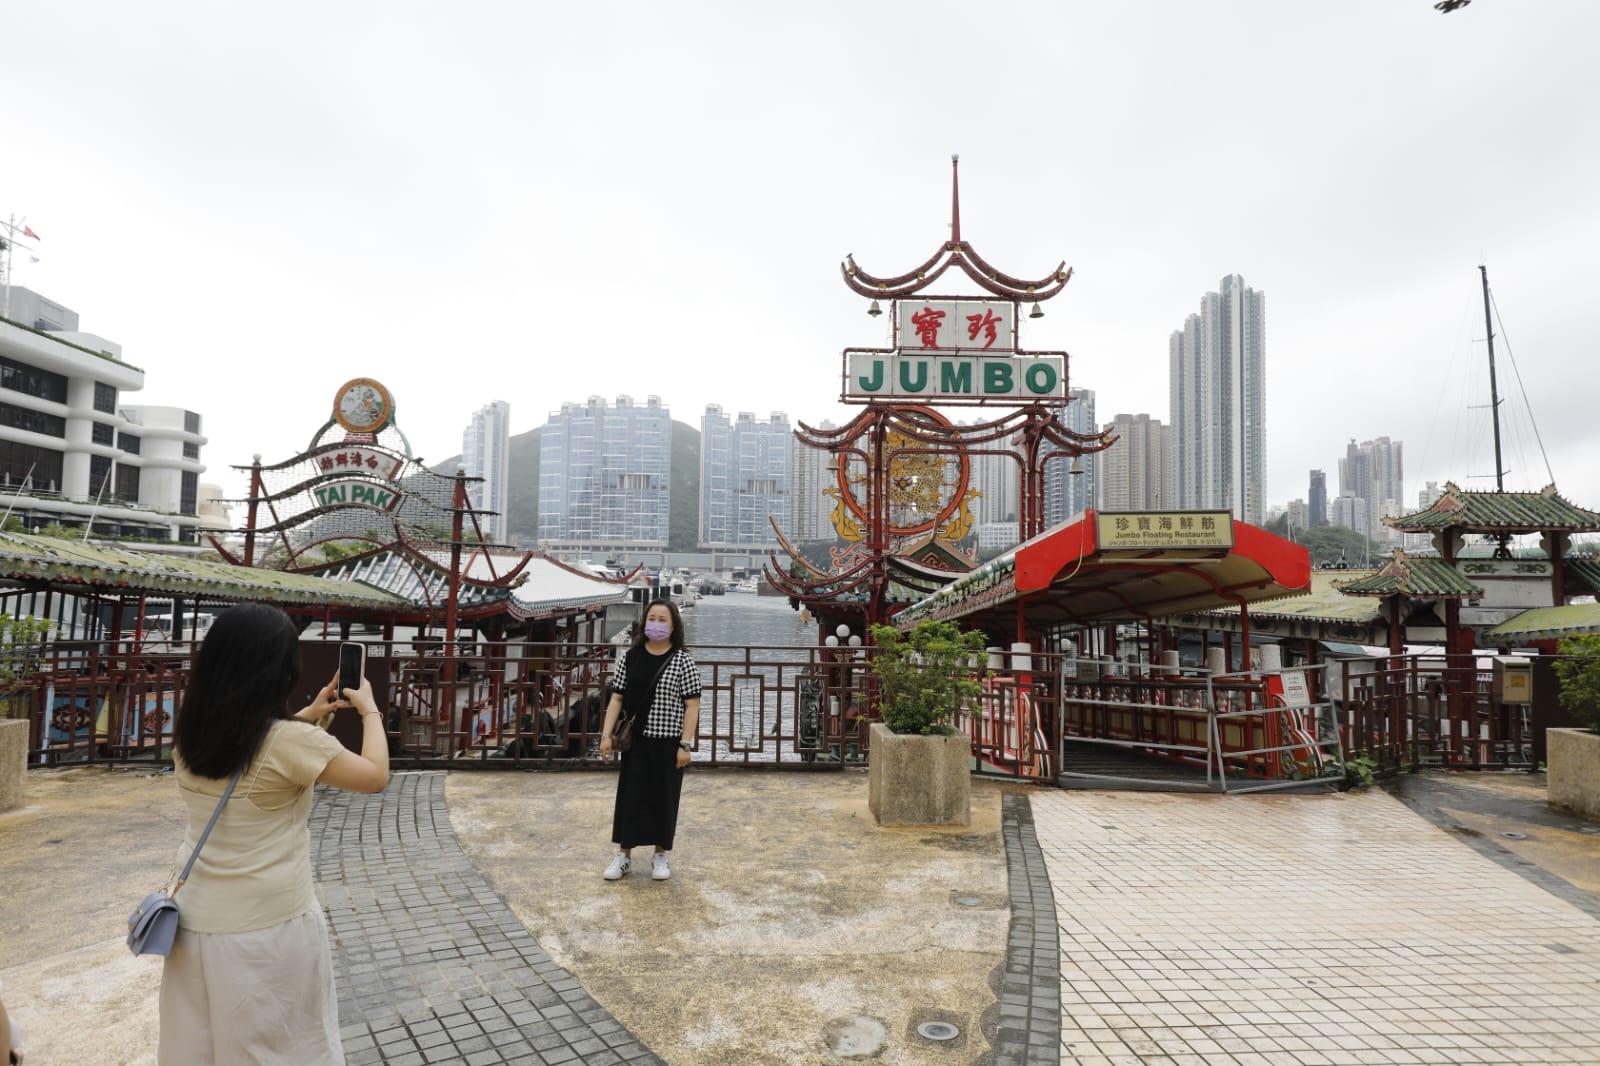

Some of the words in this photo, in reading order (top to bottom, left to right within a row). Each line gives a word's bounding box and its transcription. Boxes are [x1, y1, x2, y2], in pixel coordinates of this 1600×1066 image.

[911, 307, 1003, 350] 珍寶
[858, 360, 1057, 394] JUMBO
[315, 485, 346, 506] TAI
[352, 485, 392, 508] PAK
[1115, 517, 1215, 531] 珍寶海鮮舫
[1115, 531, 1141, 539] Jumbo
[1143, 531, 1173, 540] Floating
